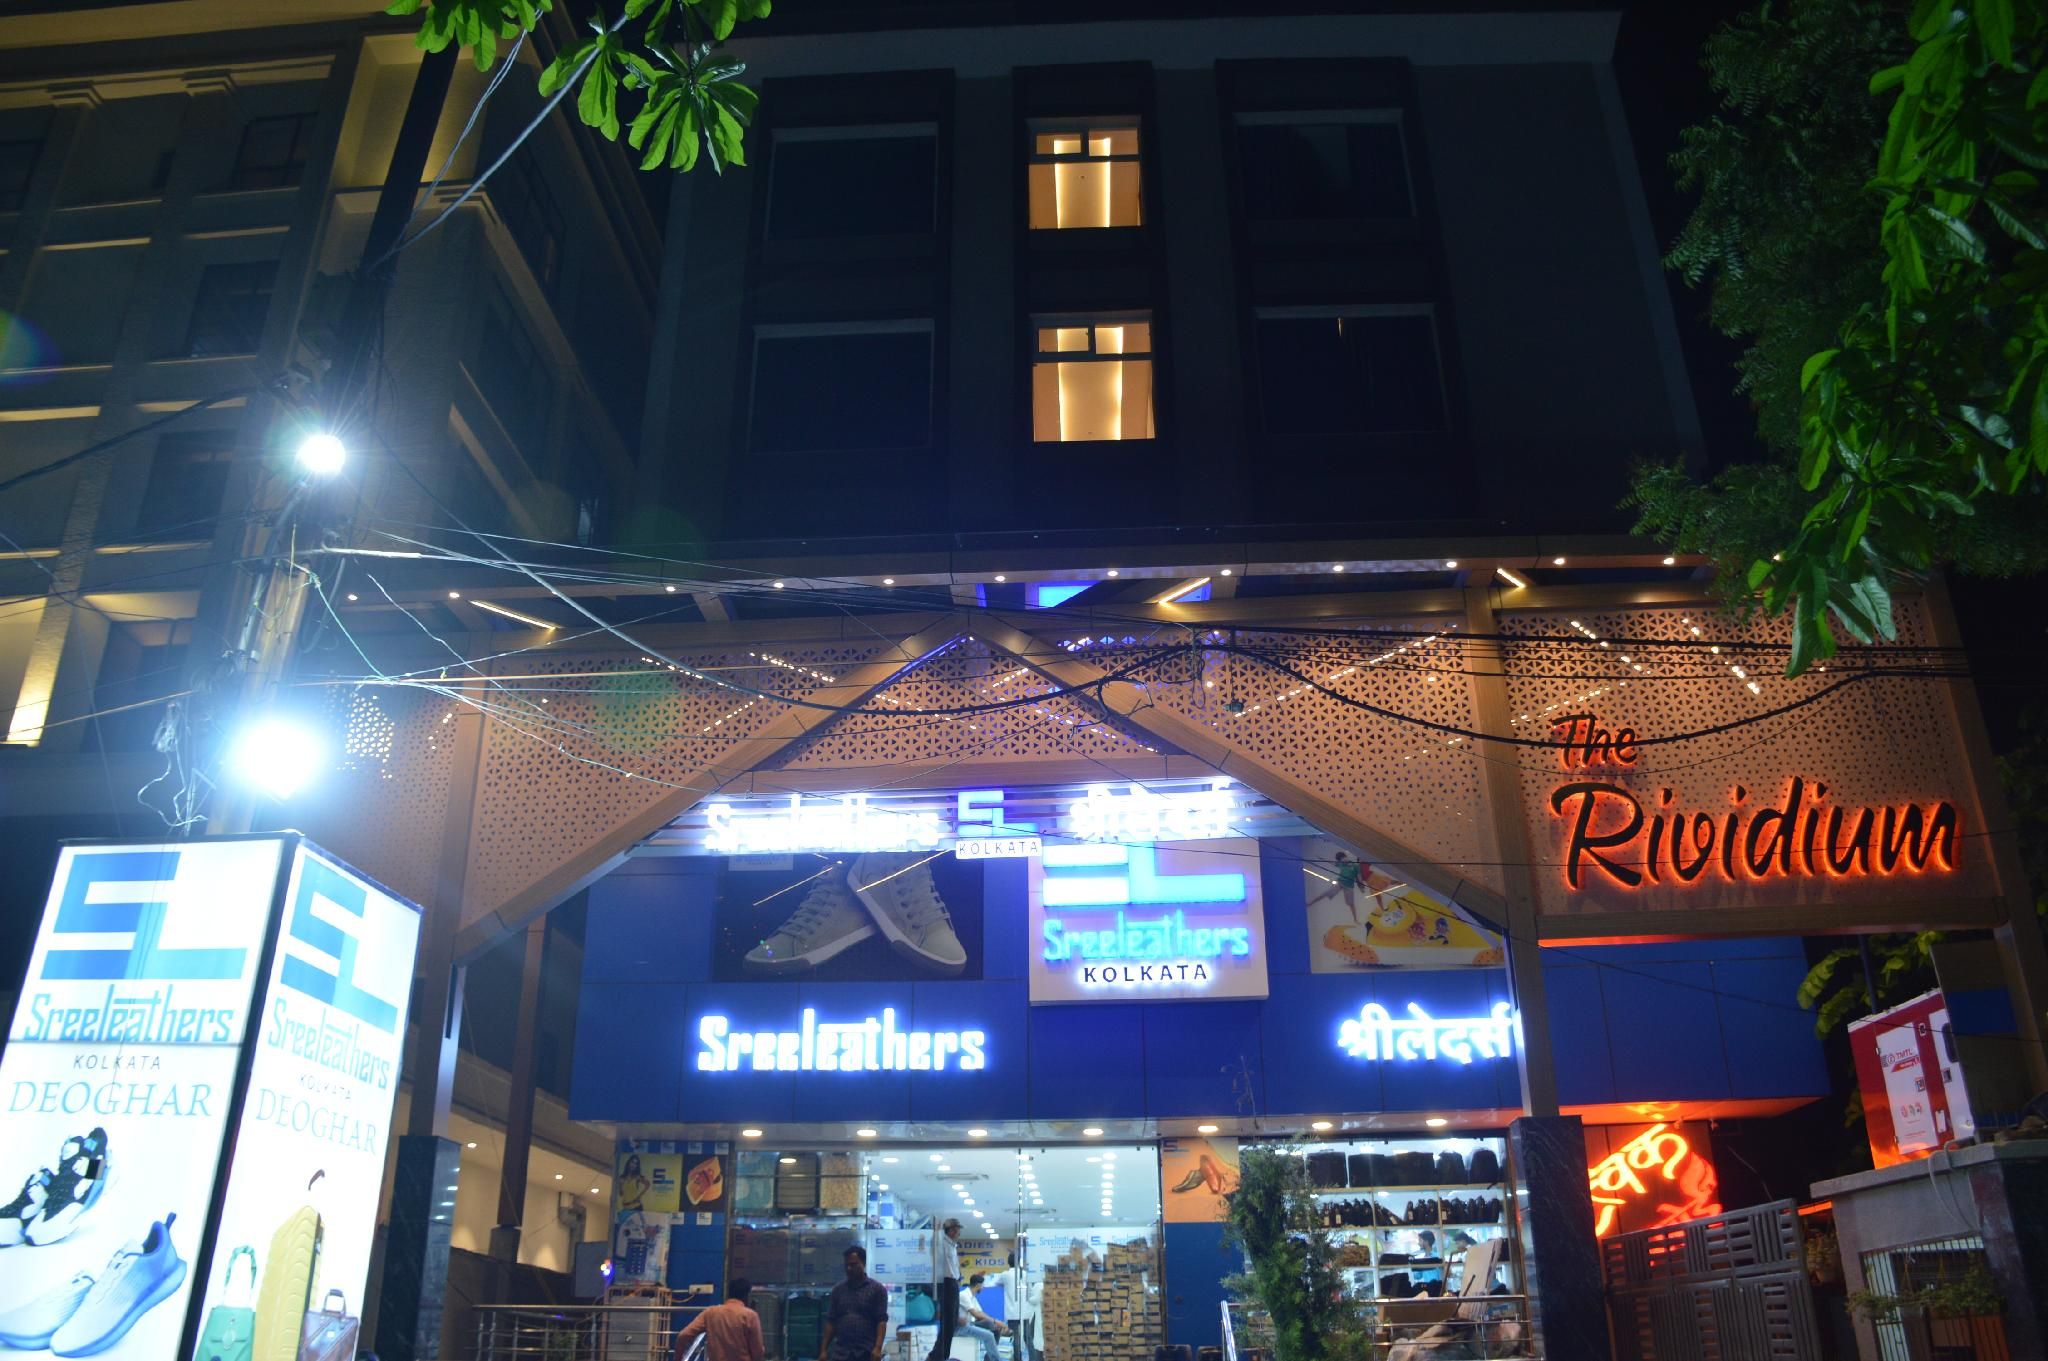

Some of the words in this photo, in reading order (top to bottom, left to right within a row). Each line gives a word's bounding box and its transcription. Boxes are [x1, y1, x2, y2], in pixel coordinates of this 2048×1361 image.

[1551, 713, 1637, 767] The
[959, 841, 1038, 854] KOLKATA
[1550, 775, 1958, 889] Rividium
[1043, 909, 1249, 961] Sreeleathers
[1083, 963, 1208, 983] KOLKATA
[23, 984, 234, 1042] Sreeleathers
[698, 1007, 985, 1072] Sreeleathers
[1338, 1002, 1511, 1065] श्रीलेदर्स
[73, 1054, 161, 1070] KOLKATA
[268, 996, 391, 1091] Sreeleathers
[8, 1081, 212, 1117] DEOGHAR
[256, 1088, 377, 1157] DEOGHAR
[975, 1258, 1005, 1266] KIDS
